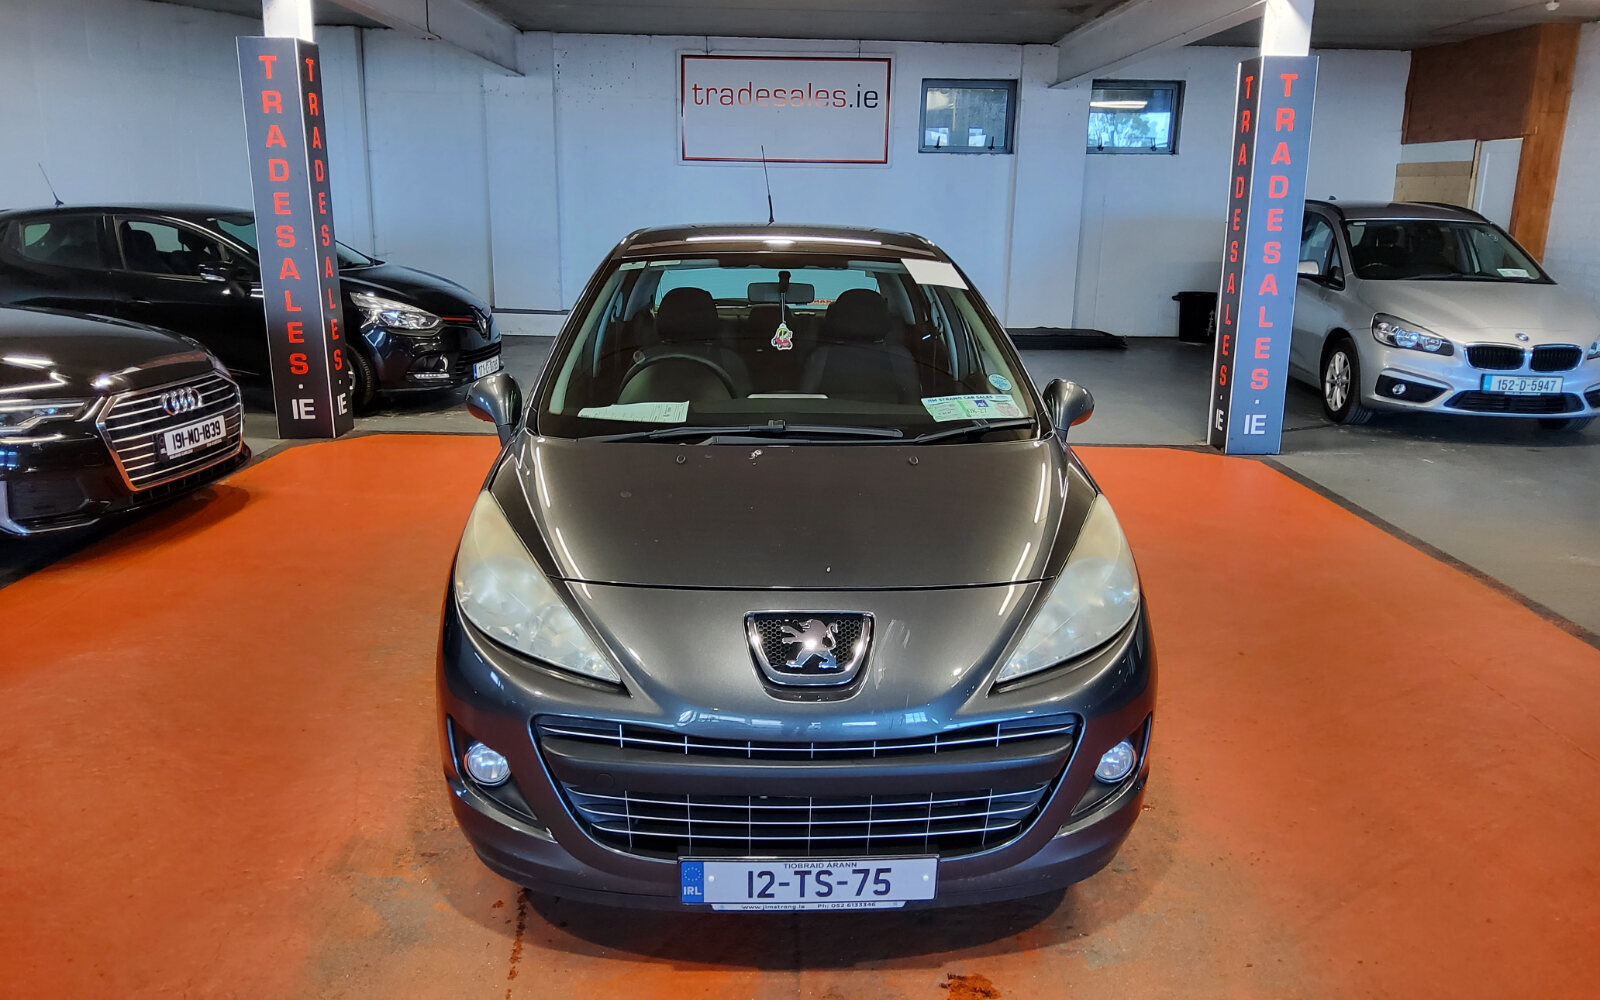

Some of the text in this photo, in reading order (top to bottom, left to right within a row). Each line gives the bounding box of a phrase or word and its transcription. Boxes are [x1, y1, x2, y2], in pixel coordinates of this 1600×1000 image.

[692, 81, 879, 109] tradesales.ie
[258, 55, 316, 420] TRADESALES.IE
[305, 58, 348, 416] TRADESALES.IE
[1215, 75, 1254, 432] TRADESALES.IE
[1243, 73, 1299, 435] TRADESALES.IE
[1497, 379, 1557, 392] 152-D-5947
[172, 420, 221, 450] 191-MO-1839
[784, 862, 825, 870] TIOBRAID
[683, 886, 702, 896] IRL
[747, 868, 892, 899] 12-TS-75
